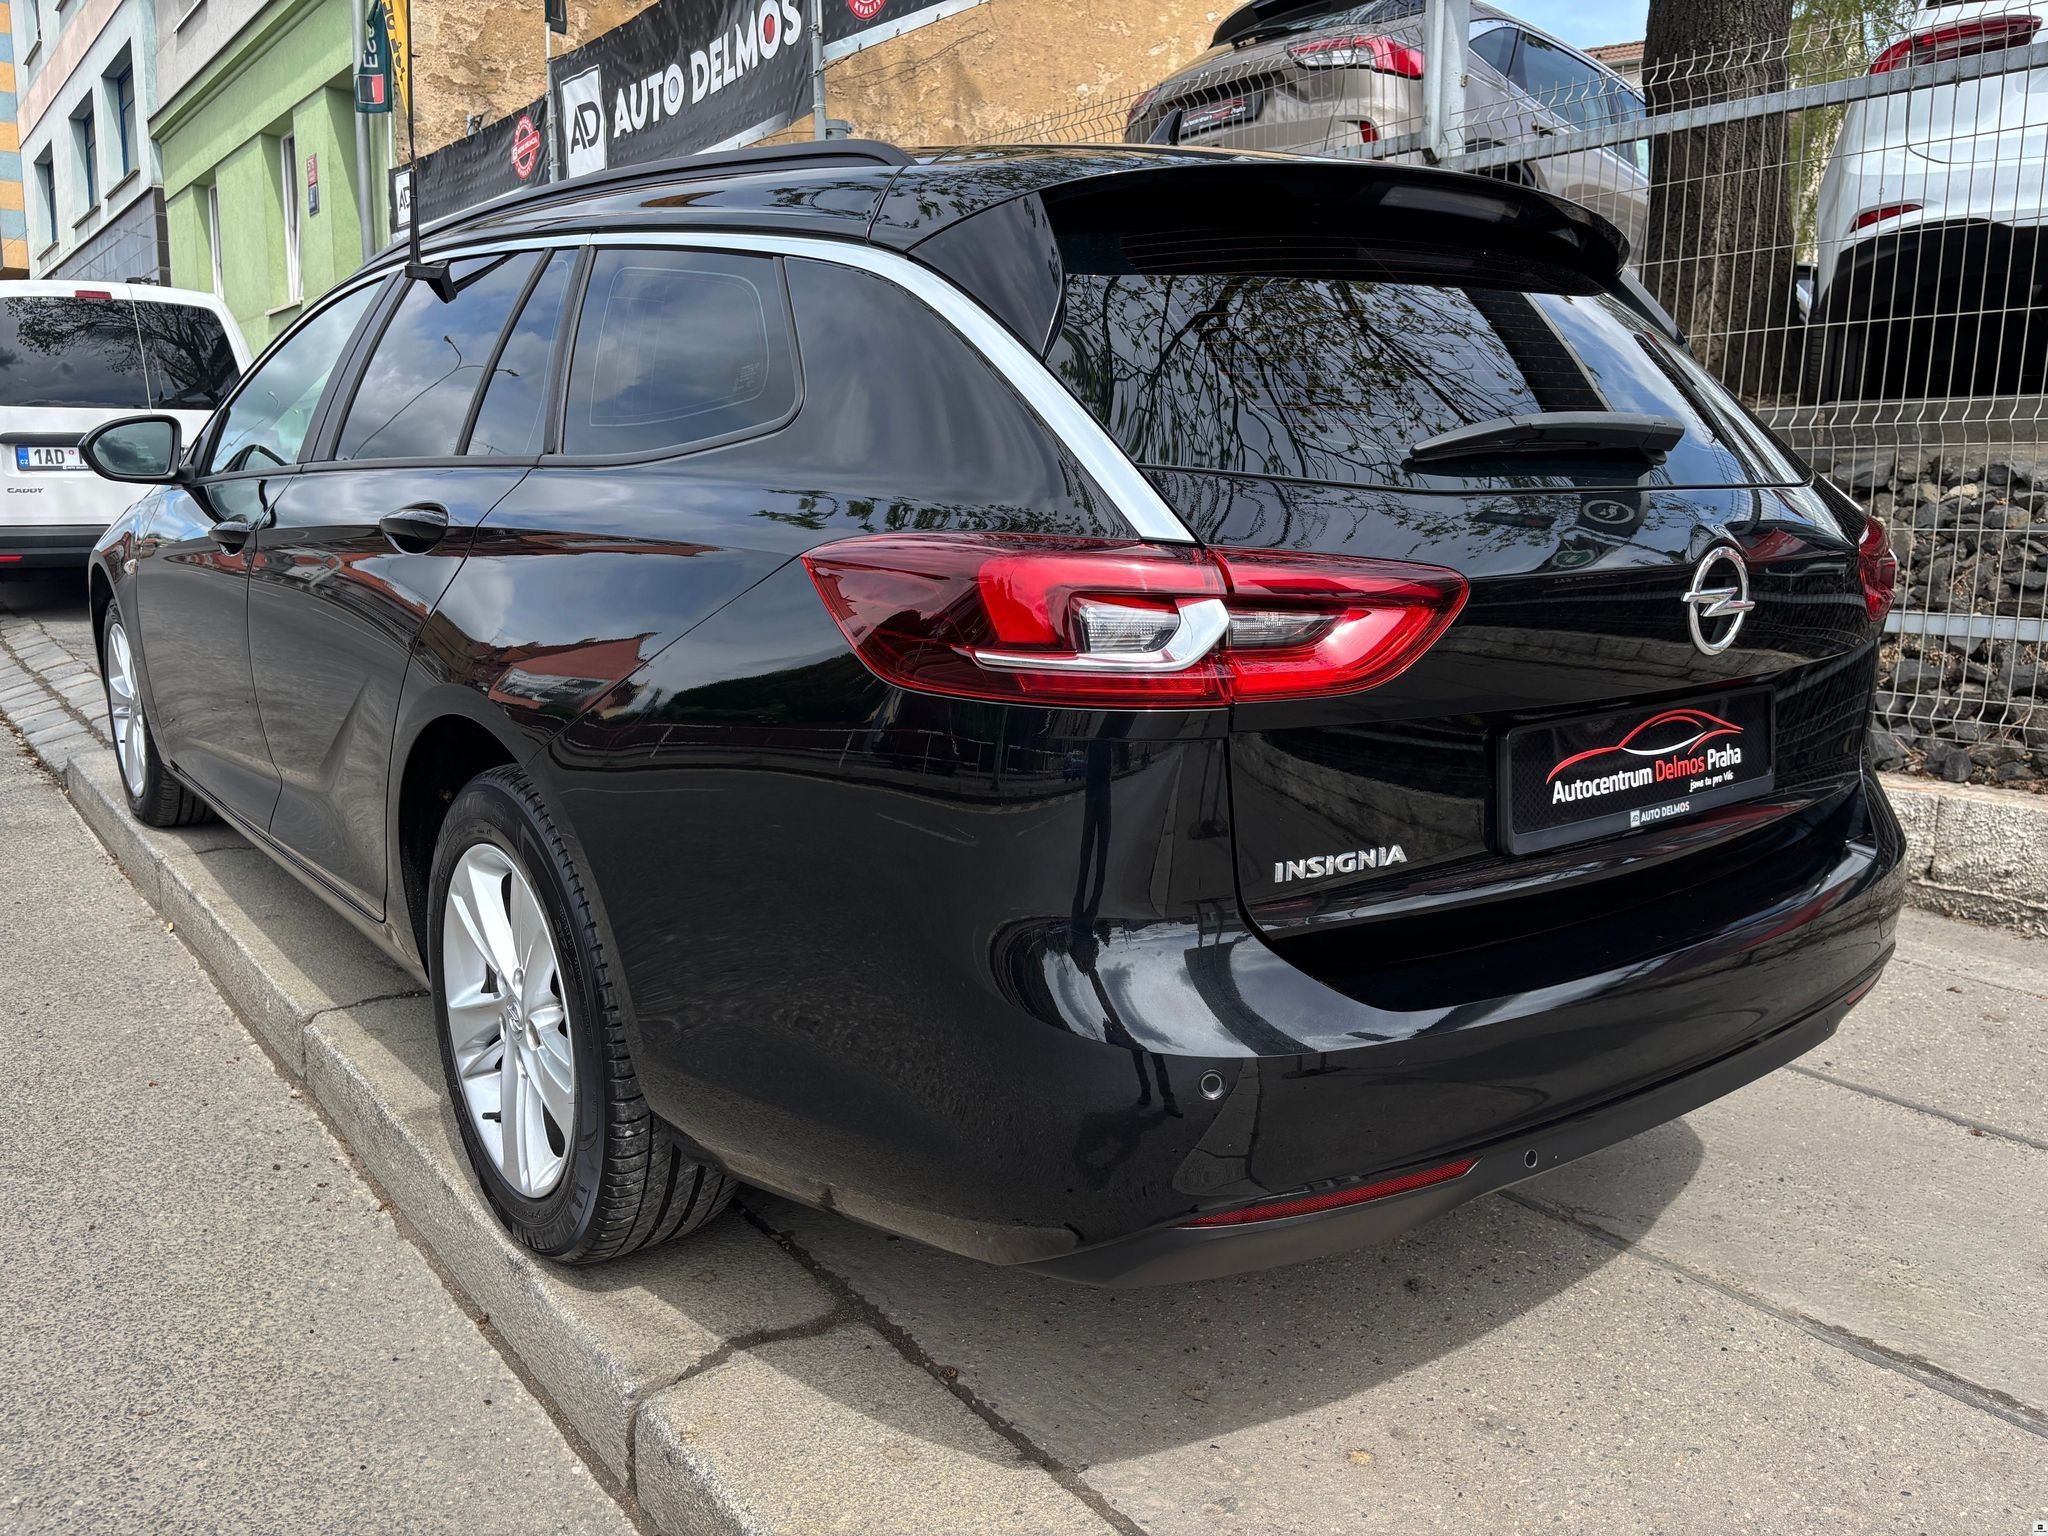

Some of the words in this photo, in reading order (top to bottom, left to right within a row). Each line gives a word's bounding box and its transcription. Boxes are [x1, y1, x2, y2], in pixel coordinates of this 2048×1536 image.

[613, 63, 685, 139] AUTO
[690, 0, 802, 105] DELMOS
[34, 449, 65, 465] 1AD
[1552, 766, 1653, 804] Autocentrum
[1655, 755, 1705, 782] Delmos
[1707, 743, 1741, 771] Praha
[1712, 774, 1723, 787] pro
[1641, 808, 1660, 822] AUTO
[1661, 801, 1690, 817] DELMOS
[1274, 844, 1408, 883] INSIGNIA
